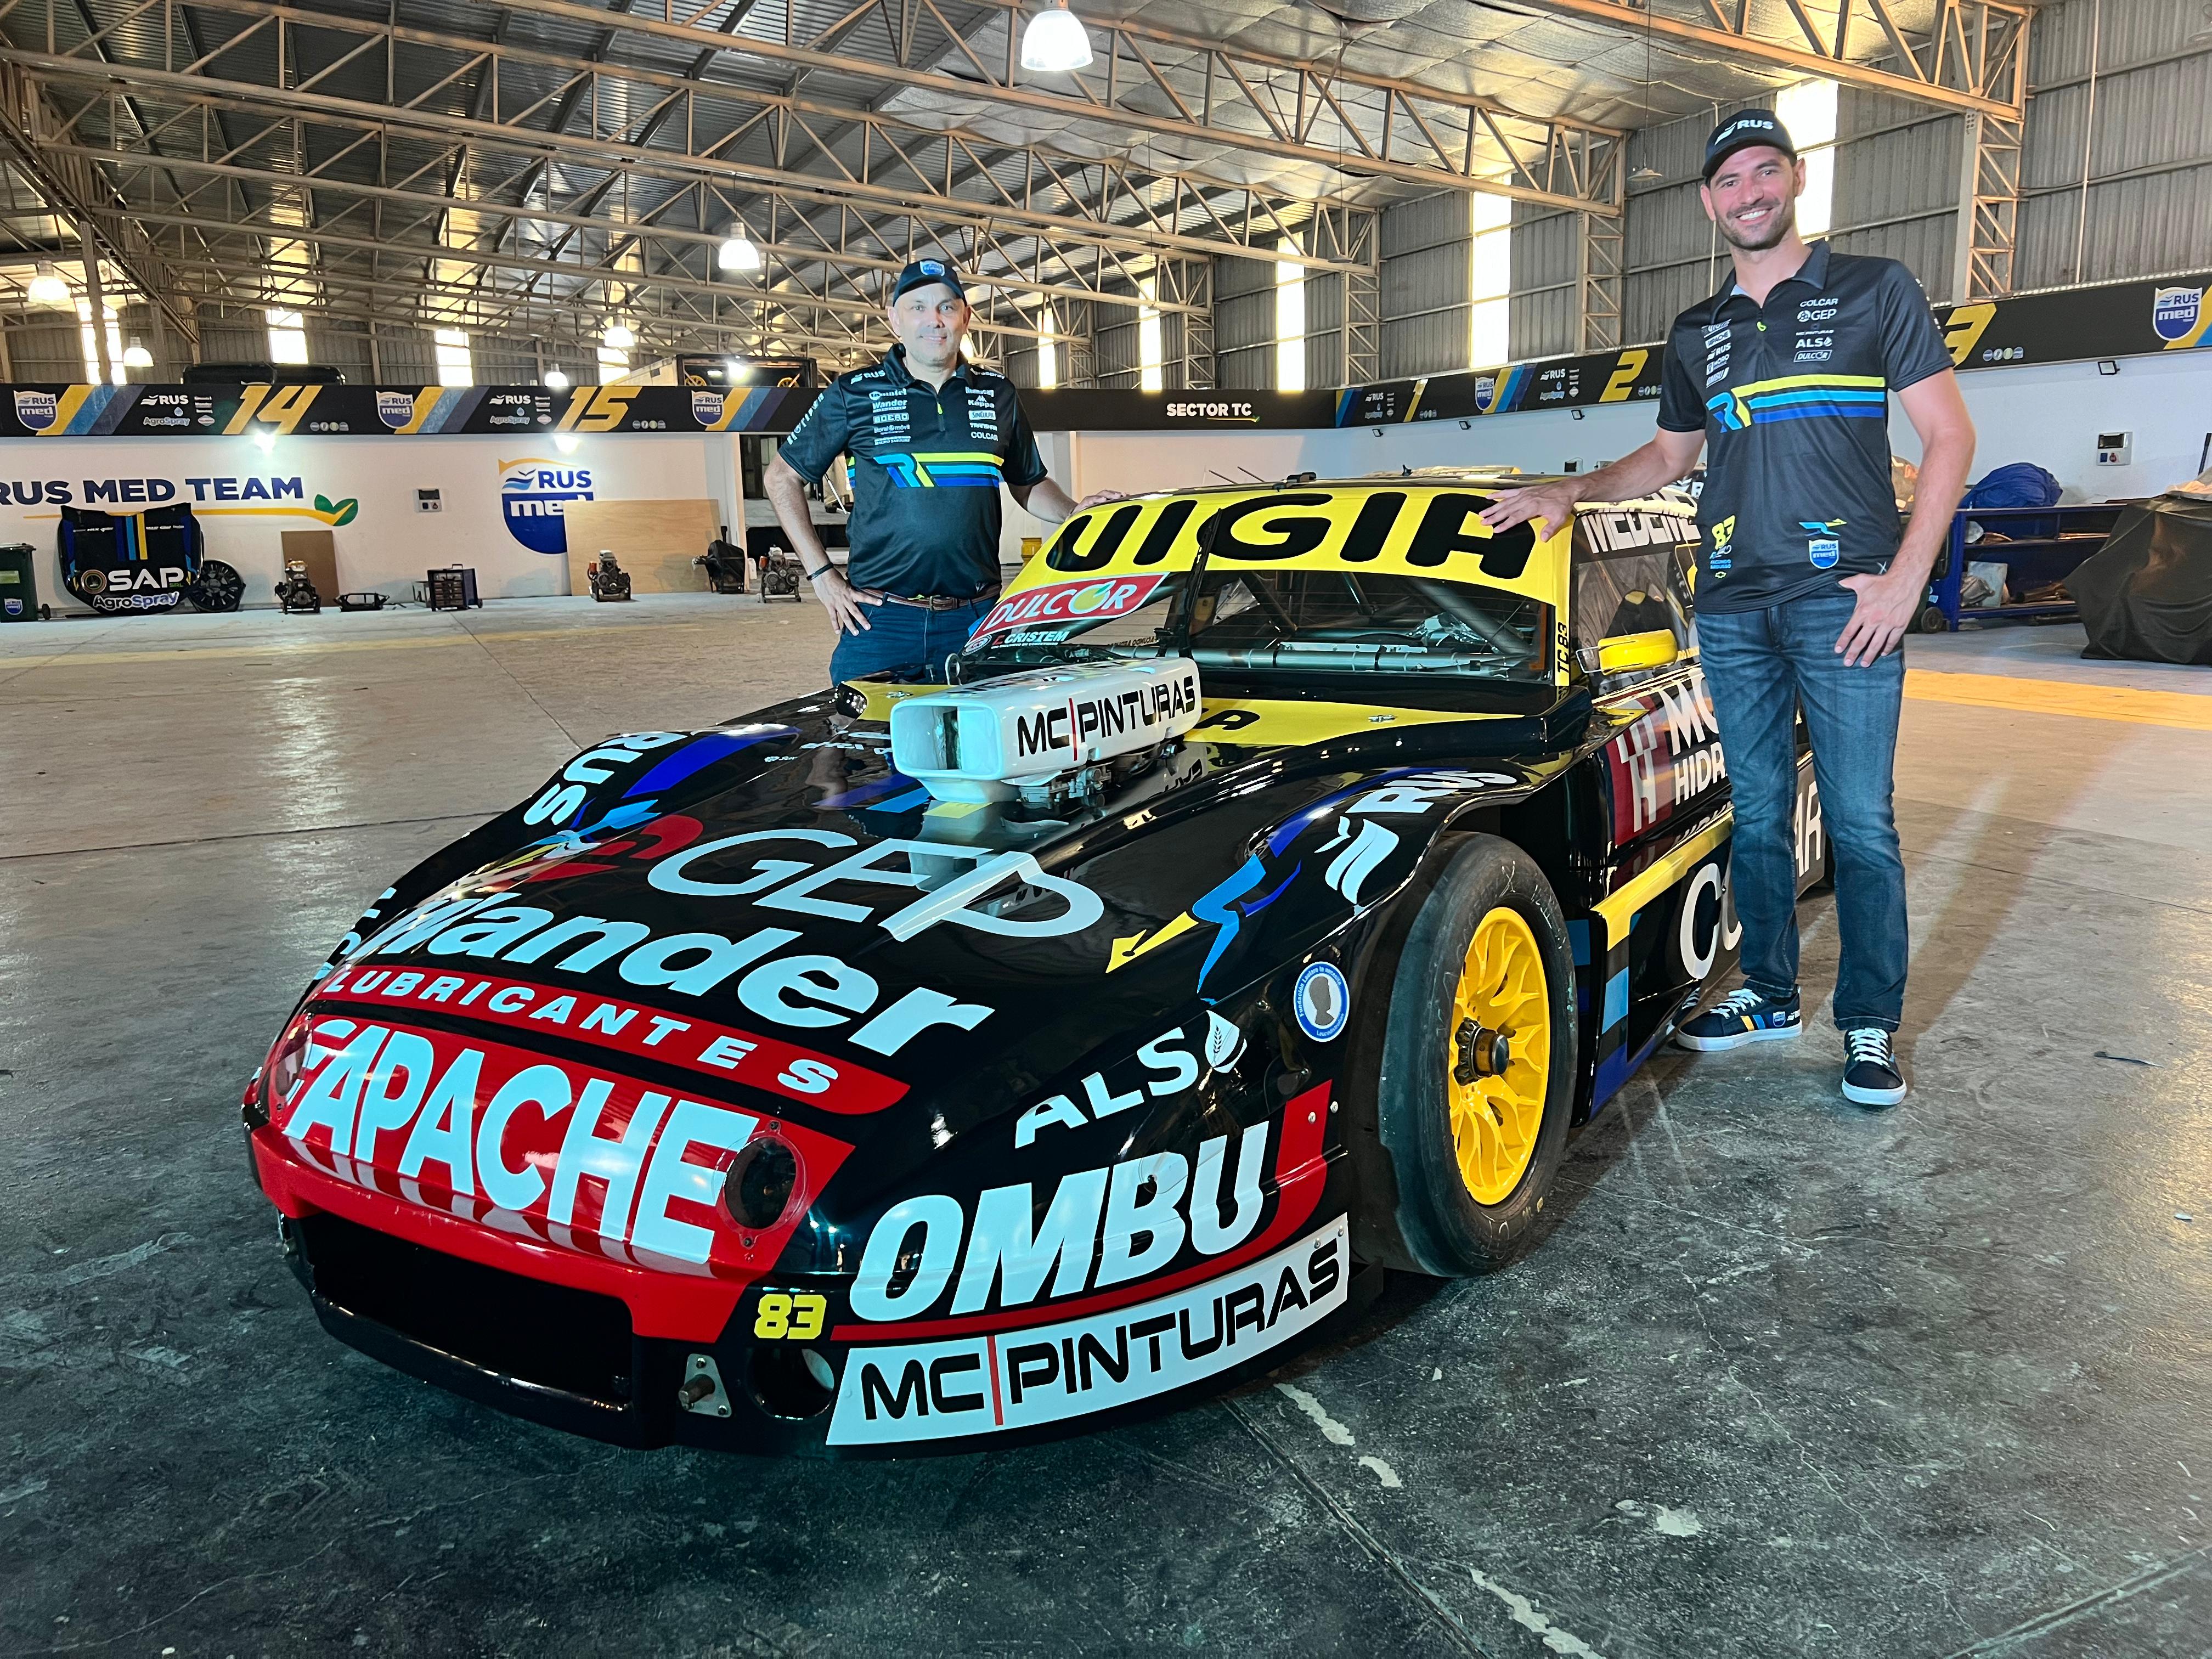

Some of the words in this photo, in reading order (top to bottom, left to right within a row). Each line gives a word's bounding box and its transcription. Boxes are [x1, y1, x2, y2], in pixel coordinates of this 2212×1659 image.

[1737, 120, 1773, 129] RUS
[1799, 298, 1838, 307] COLCAR
[2174, 294, 2199, 304] RUS
[1811, 309, 1837, 320] GEP
[2158, 306, 2195, 320] med
[1716, 342, 1731, 356] RUS
[864, 370, 885, 378] RUS
[1550, 369, 1566, 379] RUS
[1599, 349, 1649, 403] 2
[32, 397, 54, 405] RUS
[159, 395, 189, 405] RUS
[505, 395, 531, 404] RUS
[872, 399, 907, 409] Wander
[968, 399, 995, 408] Kappa
[1372, 392, 1384, 402] RUS
[21, 407, 53, 415] med
[222, 385, 323, 435] 14
[382, 407, 410, 415] med
[554, 386, 642, 432] 15
[1166, 403, 1229, 416] SECTOR
[1232, 403, 1252, 416] TC
[143, 416, 190, 427] AgroSpray
[490, 416, 531, 425] AgroSpray
[970, 431, 998, 441] COLCAR
[538, 471, 592, 488] RUS
[83, 479, 176, 504] MED
[185, 477, 304, 501] TEAM
[510, 494, 586, 516] me
[108, 567, 184, 591] SAP
[93, 591, 180, 611] AgroSpray
[987, 580, 1137, 631] DULCOR
[1004, 631, 1070, 644] CRISTEM
[1558, 622, 1569, 649] 83
[1558, 649, 1570, 673] TC
[1018, 708, 1070, 757] MC
[1080, 675, 1196, 743] PINTURAS
[523, 731, 688, 826] RUS
[1674, 741, 1729, 806] HIDR
[1345, 771, 1517, 813] RUS
[647, 828, 1104, 943] GEP
[345, 892, 996, 1057] Wander
[323, 970, 840, 1094] LUBRICANTES
[281, 1023, 759, 1264] APACHE
[850, 1121, 1269, 1322] OMBU
[754, 1294, 827, 1339] 83
[861, 1353, 985, 1420] MC
[1006, 1237, 1340, 1404] PINTURAS
